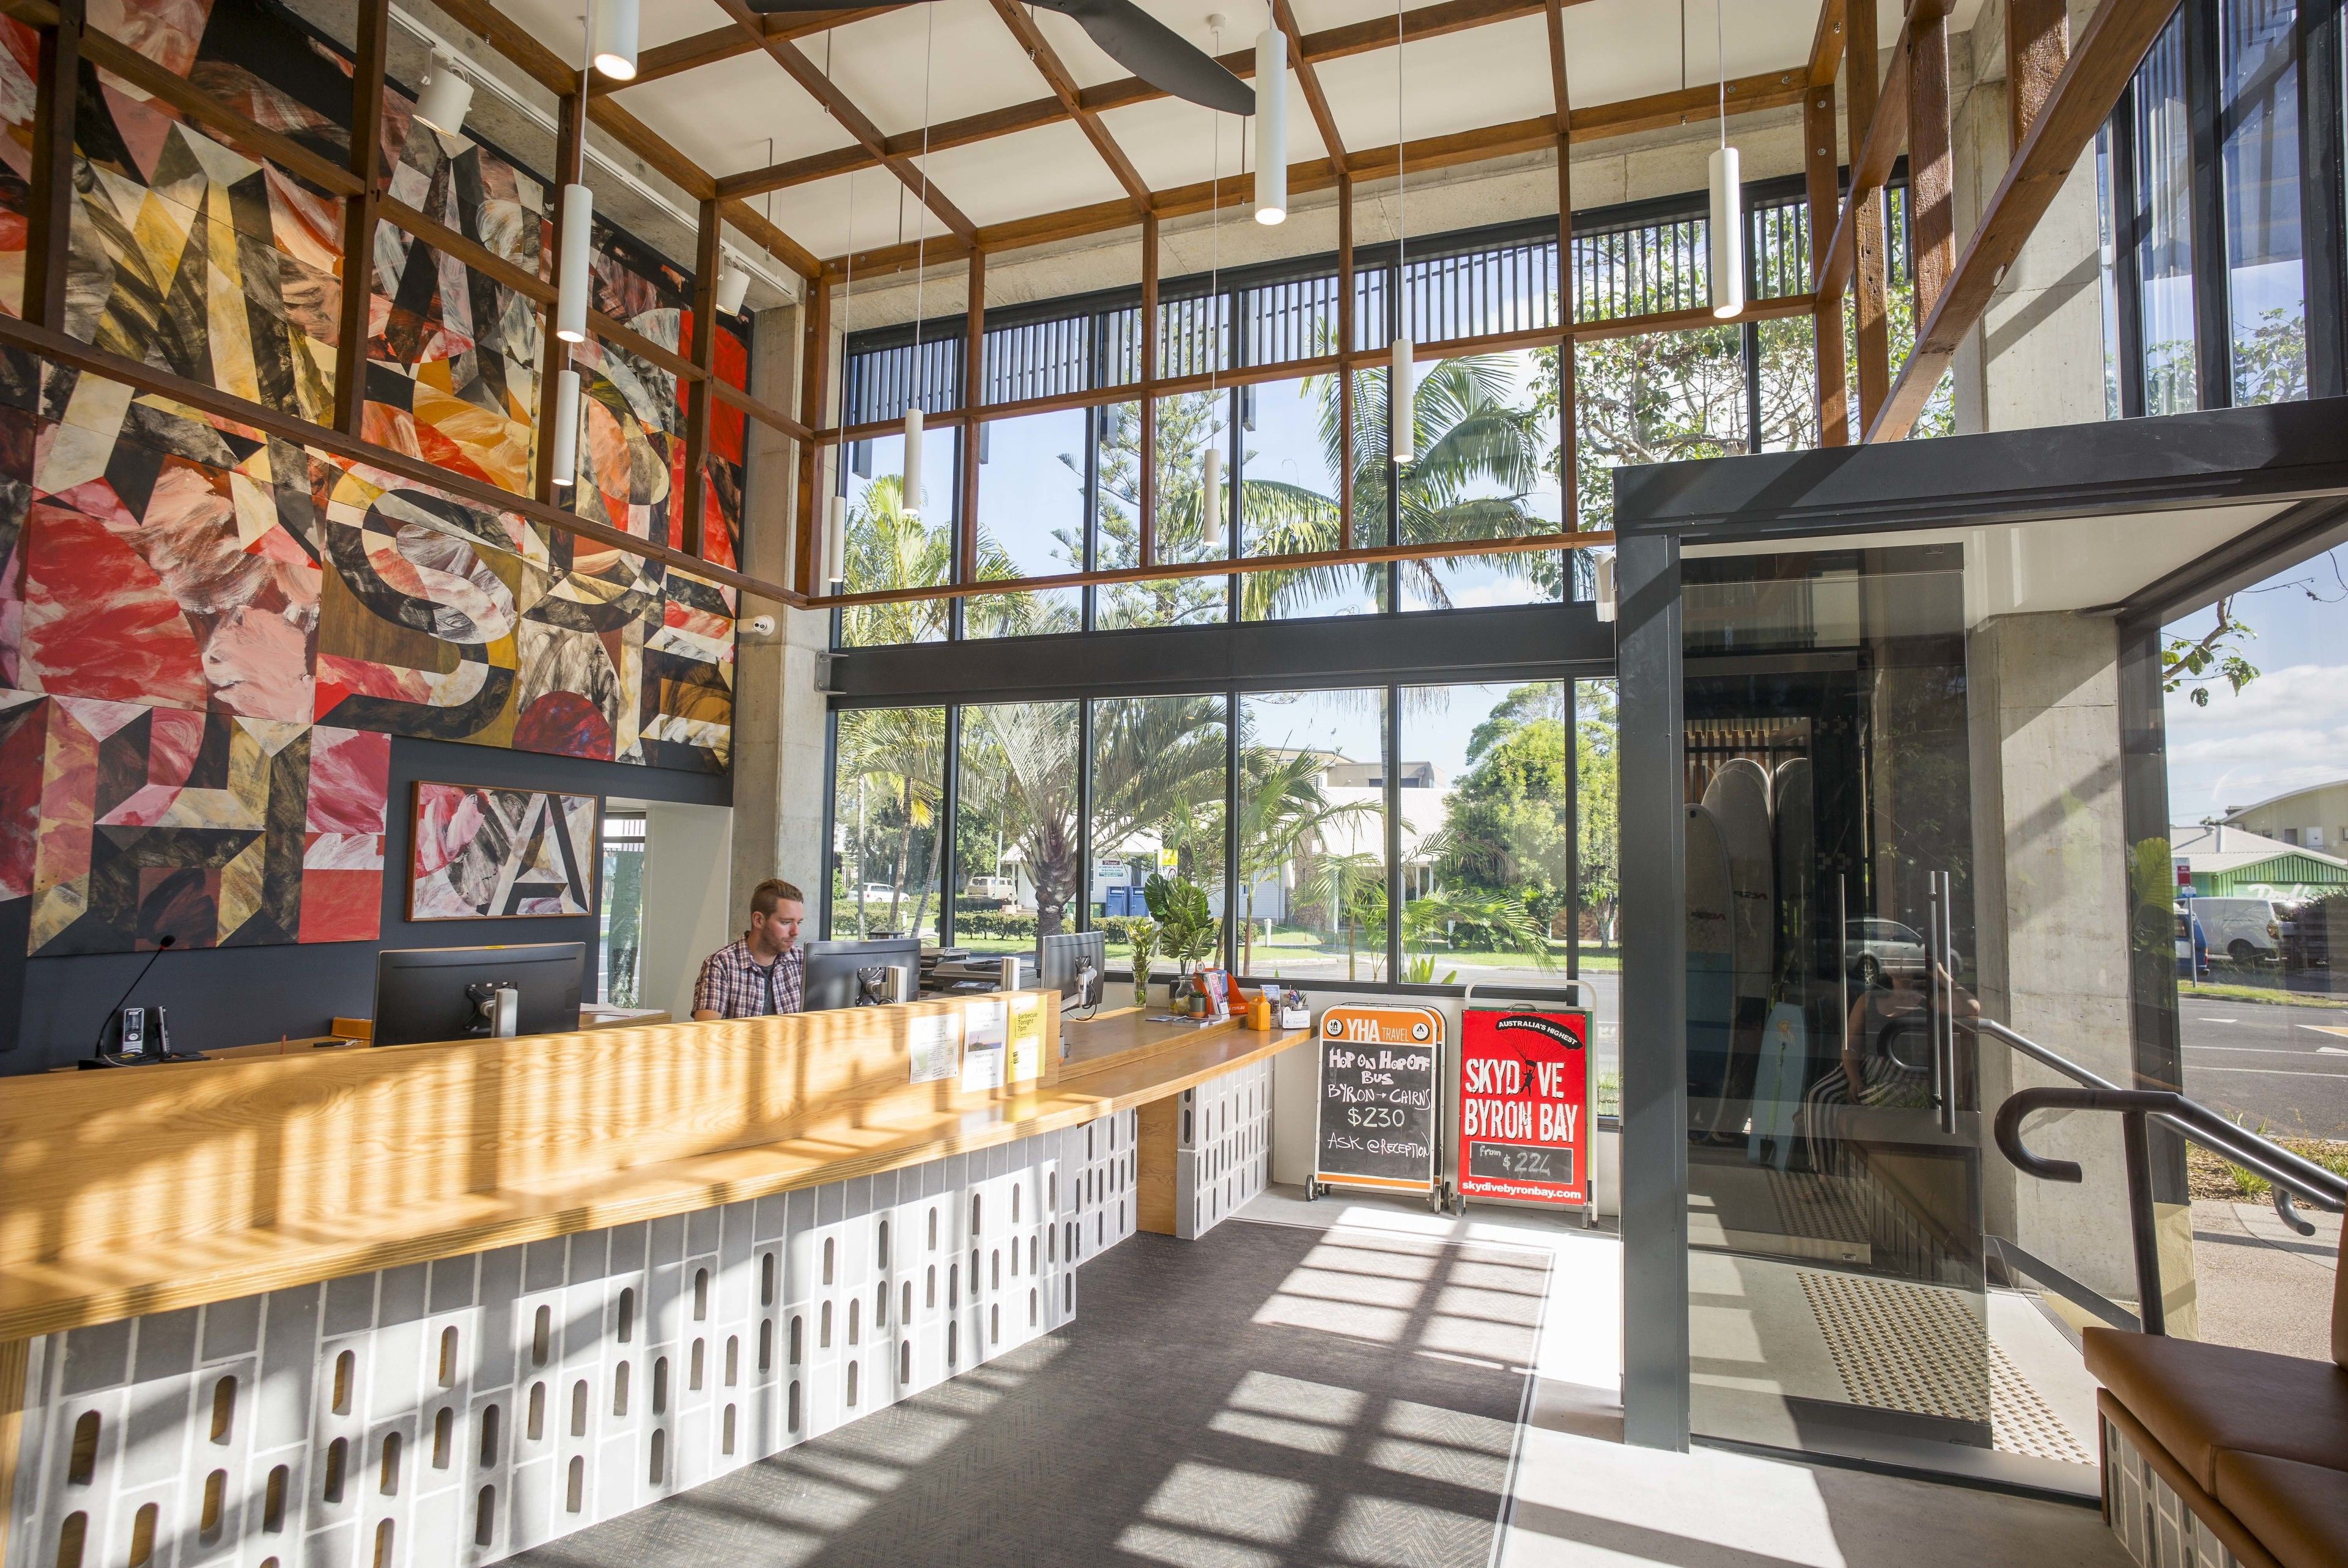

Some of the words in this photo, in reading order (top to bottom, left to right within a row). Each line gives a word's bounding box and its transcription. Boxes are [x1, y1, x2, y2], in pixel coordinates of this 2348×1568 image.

[1346, 1018, 1380, 1042] YHA
[1382, 1027, 1409, 1042] TRAVEL
[1499, 1020, 1546, 1031] AUSTRALIA'S
[1546, 1026, 1578, 1045] HIGHEST
[1357, 1053, 1376, 1070] ON
[1406, 1054, 1430, 1071] OFF
[1361, 1070, 1394, 1084] BUS
[1328, 1083, 1375, 1103] BYRON
[1389, 1089, 1430, 1110] CAIRNS
[1347, 1106, 1405, 1127] $230
[1464, 1099, 1532, 1139] BYRON
[1540, 1102, 1578, 1143] BAY
[1327, 1132, 1364, 1150] ASK
[1462, 1180, 1581, 1199] skydivebyronbay.com
